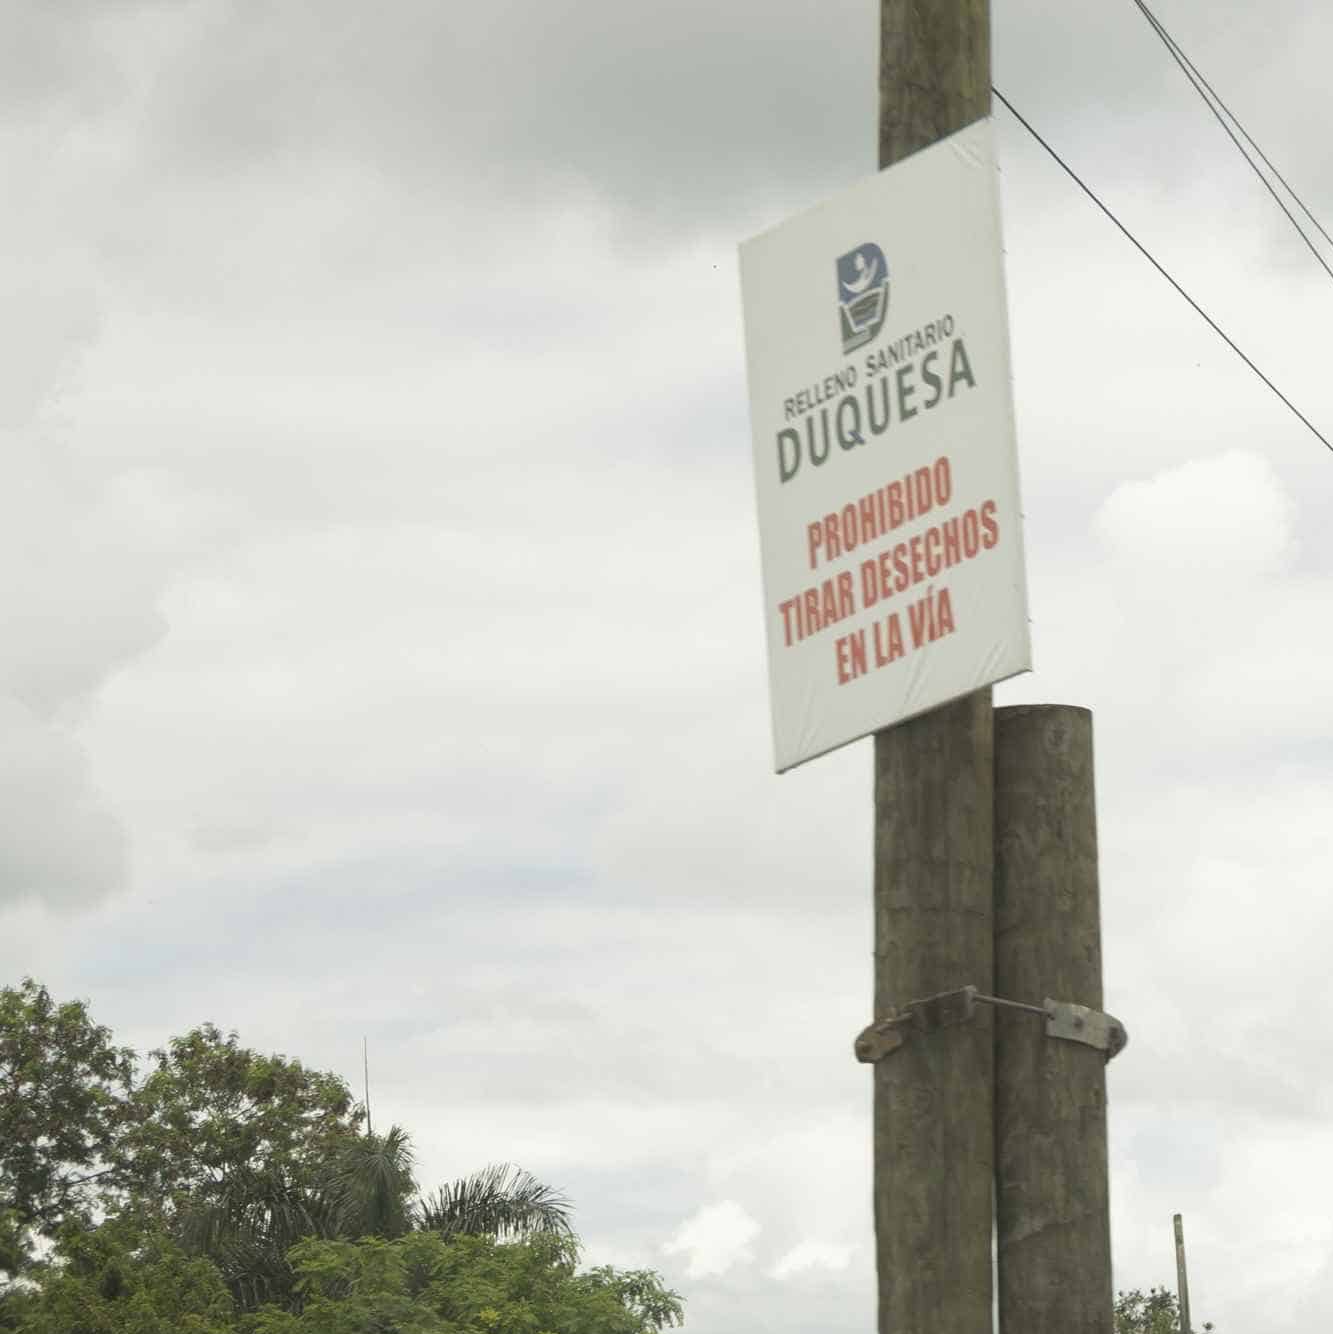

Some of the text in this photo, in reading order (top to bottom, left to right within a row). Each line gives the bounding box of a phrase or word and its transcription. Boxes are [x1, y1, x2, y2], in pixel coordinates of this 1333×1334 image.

[776, 338, 977, 484] DUQUESA
[784, 313, 955, 421] RELLENO SANITARIO
[807, 456, 952, 570] PROHIBIDO
[778, 499, 999, 648] TIRAR DESECHOS
[835, 584, 956, 686] EN LA VÍA
